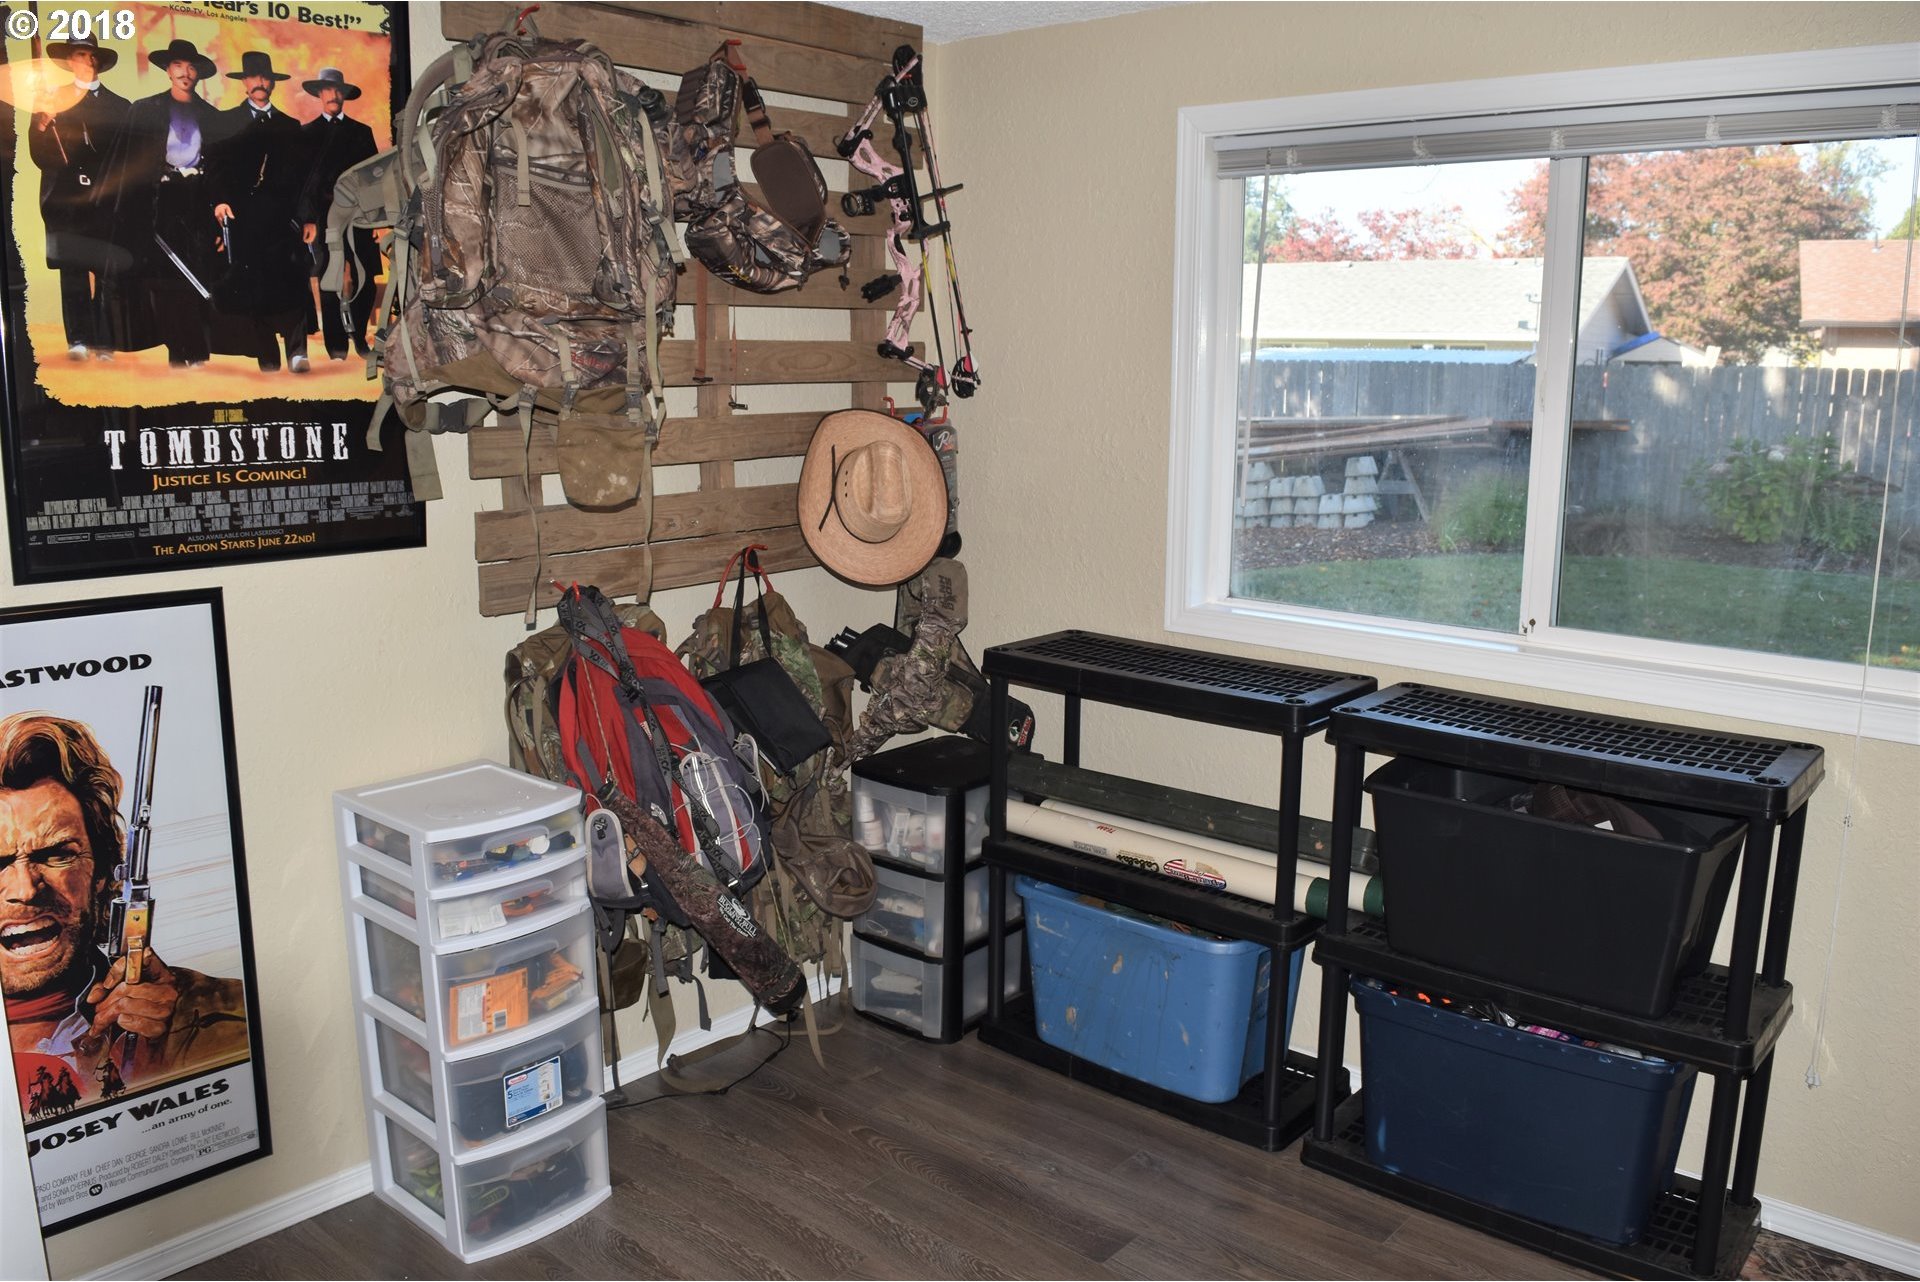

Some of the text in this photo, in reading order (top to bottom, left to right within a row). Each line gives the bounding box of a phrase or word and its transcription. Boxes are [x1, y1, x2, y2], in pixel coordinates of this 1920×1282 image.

[207, 10, 218, 18] Los
[221, 14, 248, 22] Angeles
[104, 422, 349, 470] TOMBSTONE
[153, 466, 307, 491] JUSTICE IS COMING!
[153, 532, 316, 556] THE ACTION STARTS JUNE 22ND!
[206, 532, 239, 540] AVAILABLE
[128, 1078, 229, 1121] WALES
[168, 1110, 197, 1124] army
[198, 1104, 209, 1114] of
[211, 1099, 232, 1110] one.
[199, 1146, 212, 1156] PG
